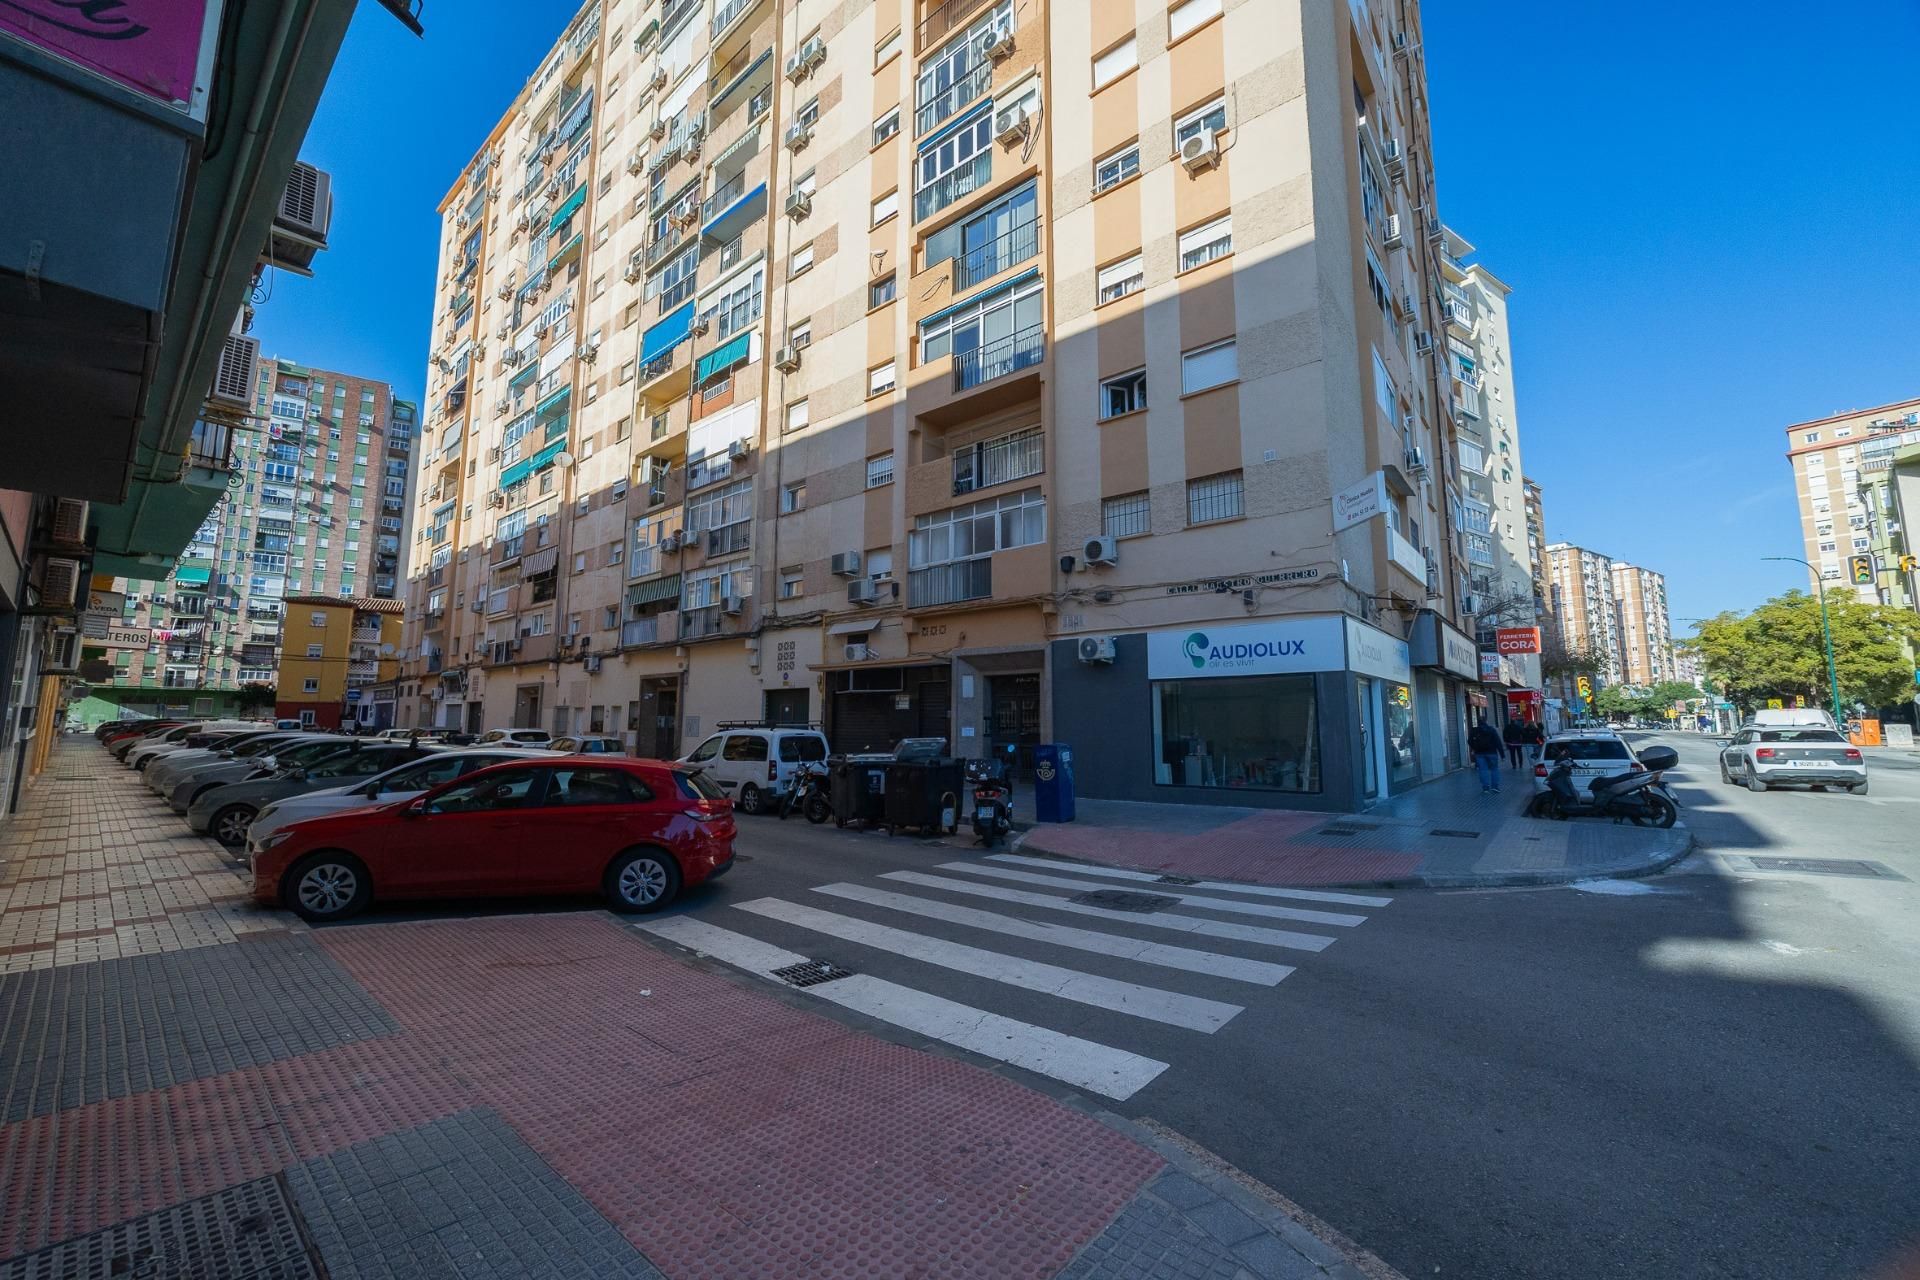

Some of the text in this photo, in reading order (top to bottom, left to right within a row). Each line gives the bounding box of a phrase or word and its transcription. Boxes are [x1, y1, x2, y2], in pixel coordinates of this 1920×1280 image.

[1257, 568, 1318, 584] GUERRERO
[86, 632, 147, 643] TEROS
[1209, 640, 1305, 660] AUDIOLUX
[1500, 640, 1537, 650] CORA
[1223, 660, 1234, 668] es
